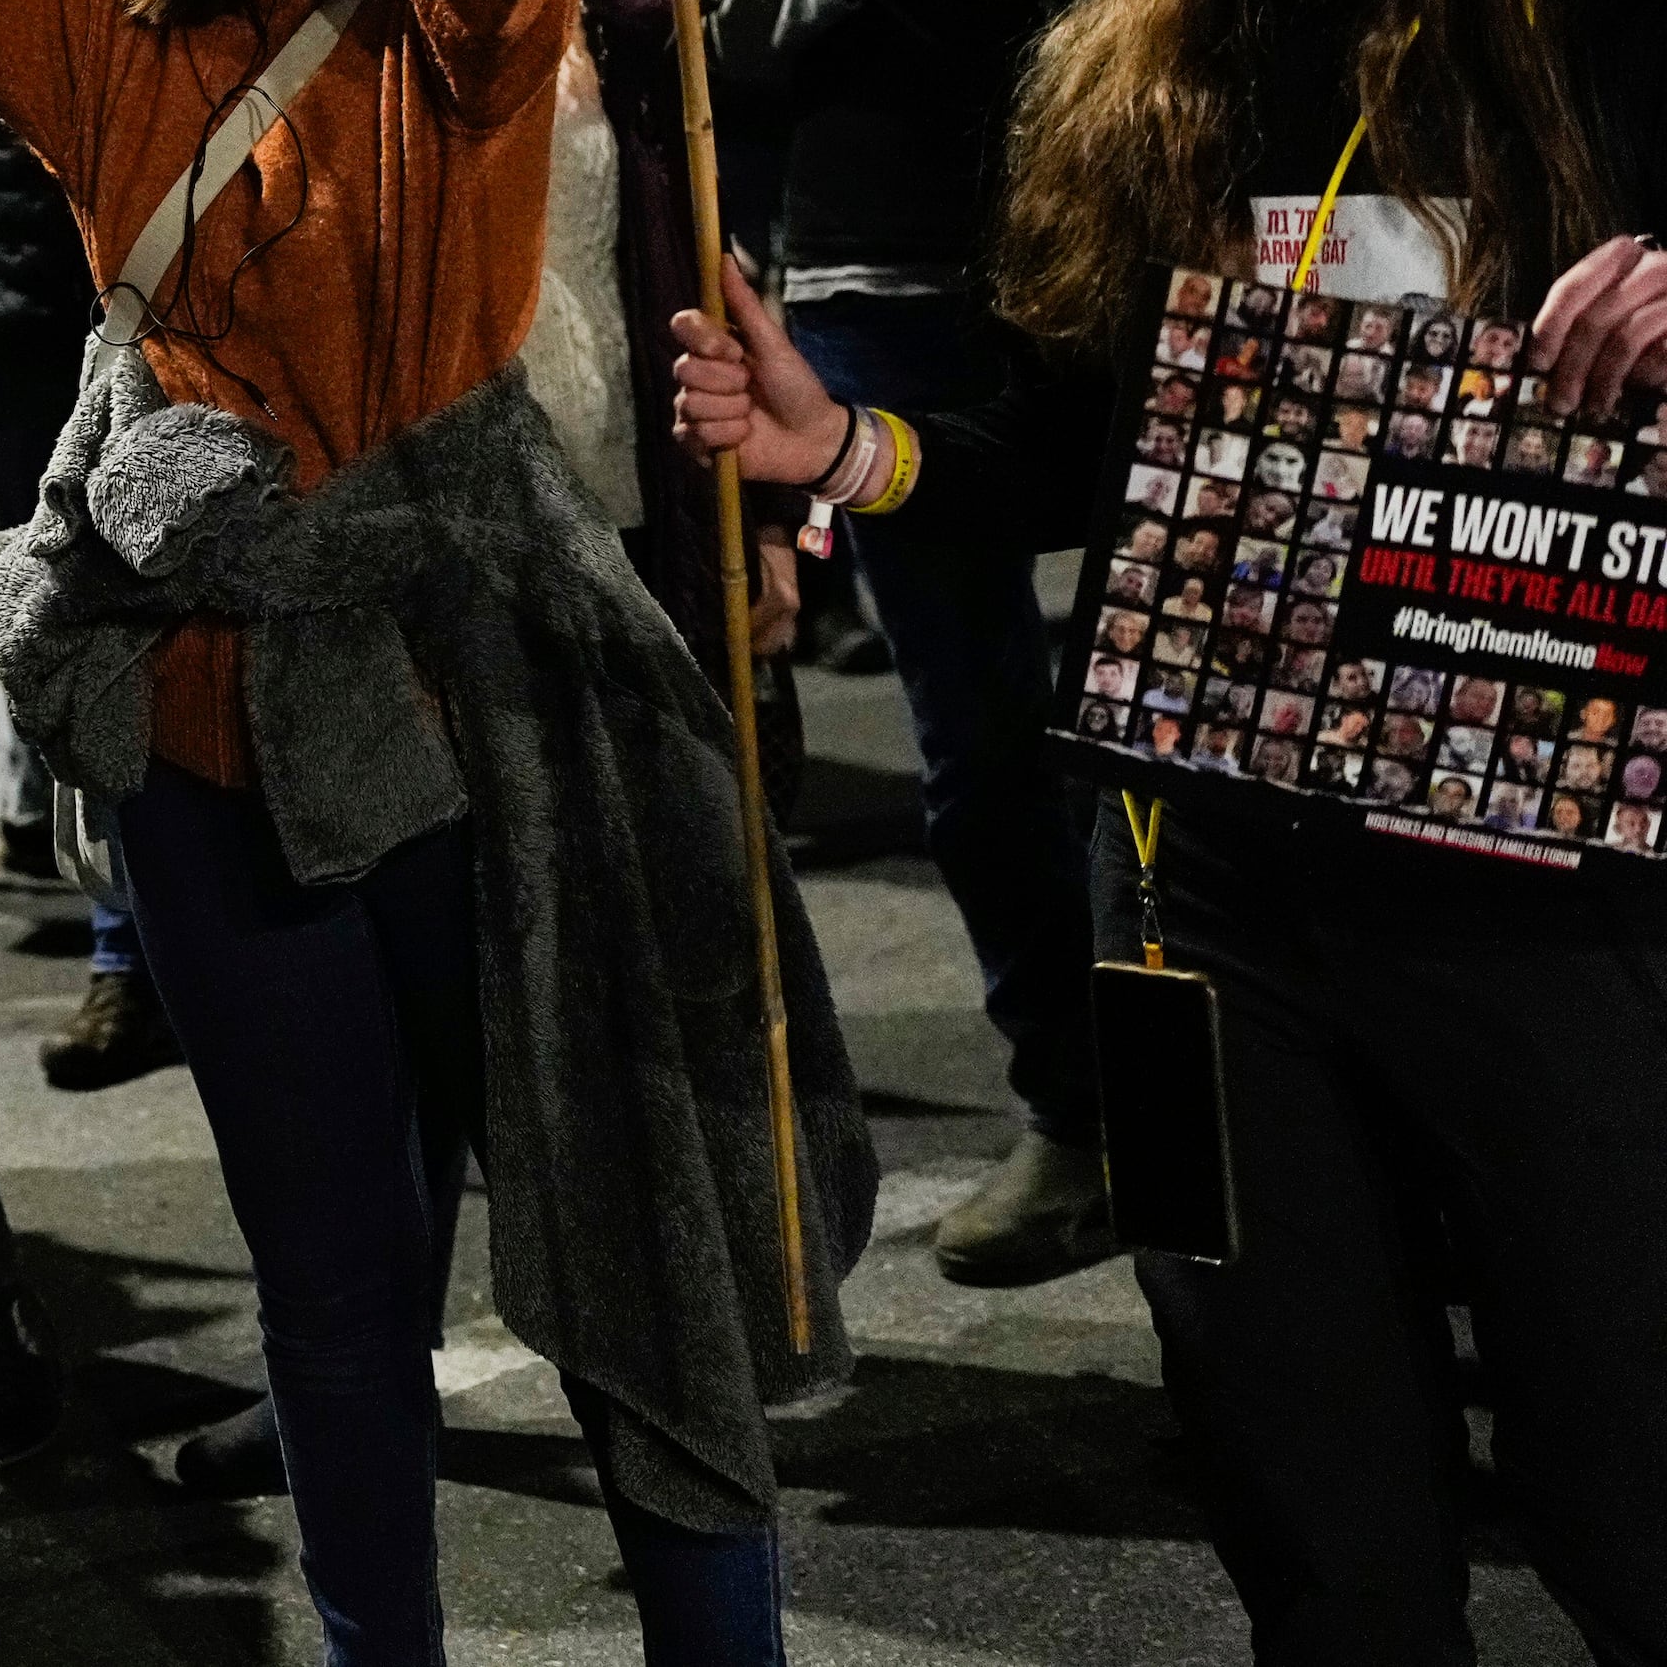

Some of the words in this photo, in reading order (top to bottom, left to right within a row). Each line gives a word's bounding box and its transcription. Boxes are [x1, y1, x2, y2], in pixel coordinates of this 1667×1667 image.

[1321, 239, 1347, 266] GAT
[1371, 483, 1444, 547] WE
[1450, 493, 1598, 572] WON'T
[1601, 520, 1667, 589] ST
[1359, 545, 1437, 593] UNTIL
[1447, 557, 1564, 614] THEY'RE
[1567, 580, 1617, 624] ALL
